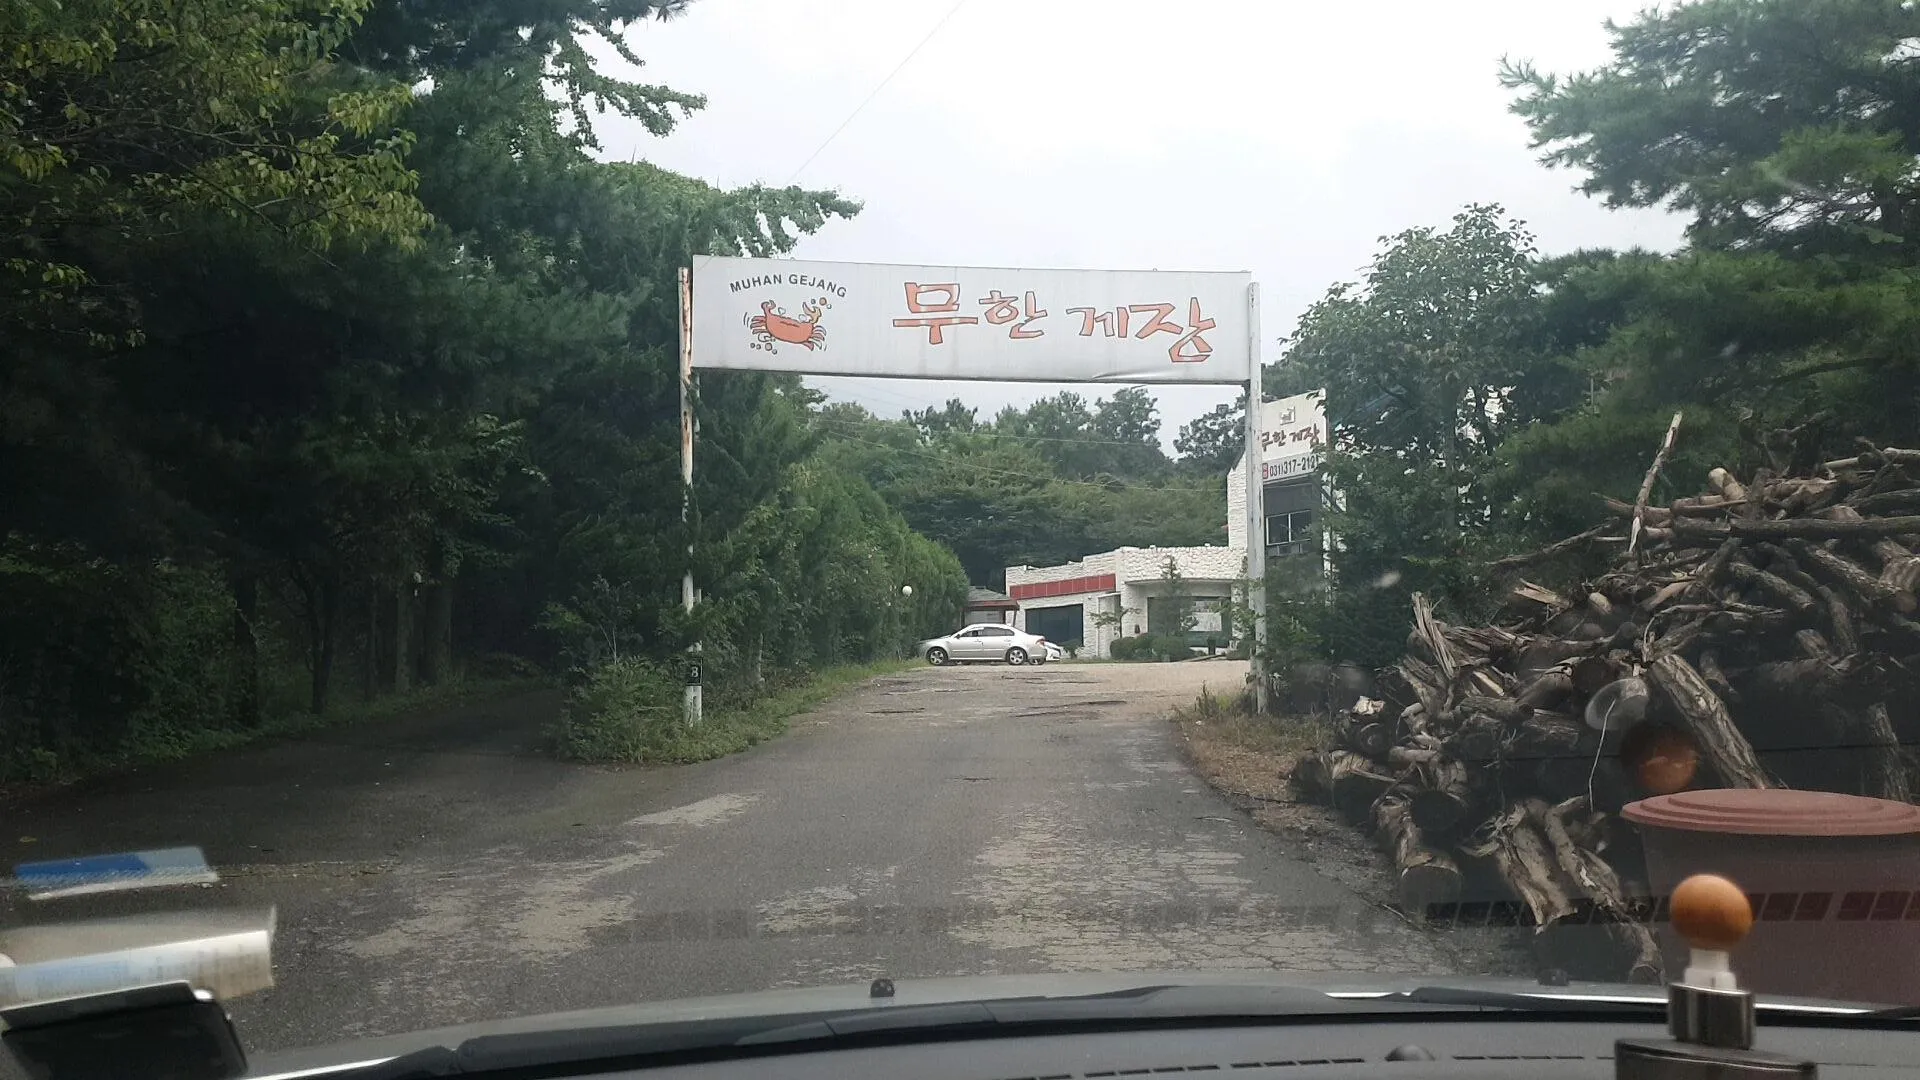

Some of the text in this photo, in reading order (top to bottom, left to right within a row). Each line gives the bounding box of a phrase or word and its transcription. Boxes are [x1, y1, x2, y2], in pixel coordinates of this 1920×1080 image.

[730, 274, 847, 297] MUHAN GEJANG
[893, 282, 1216, 363] 무한 게장
[1289, 423, 1320, 450] 게장
